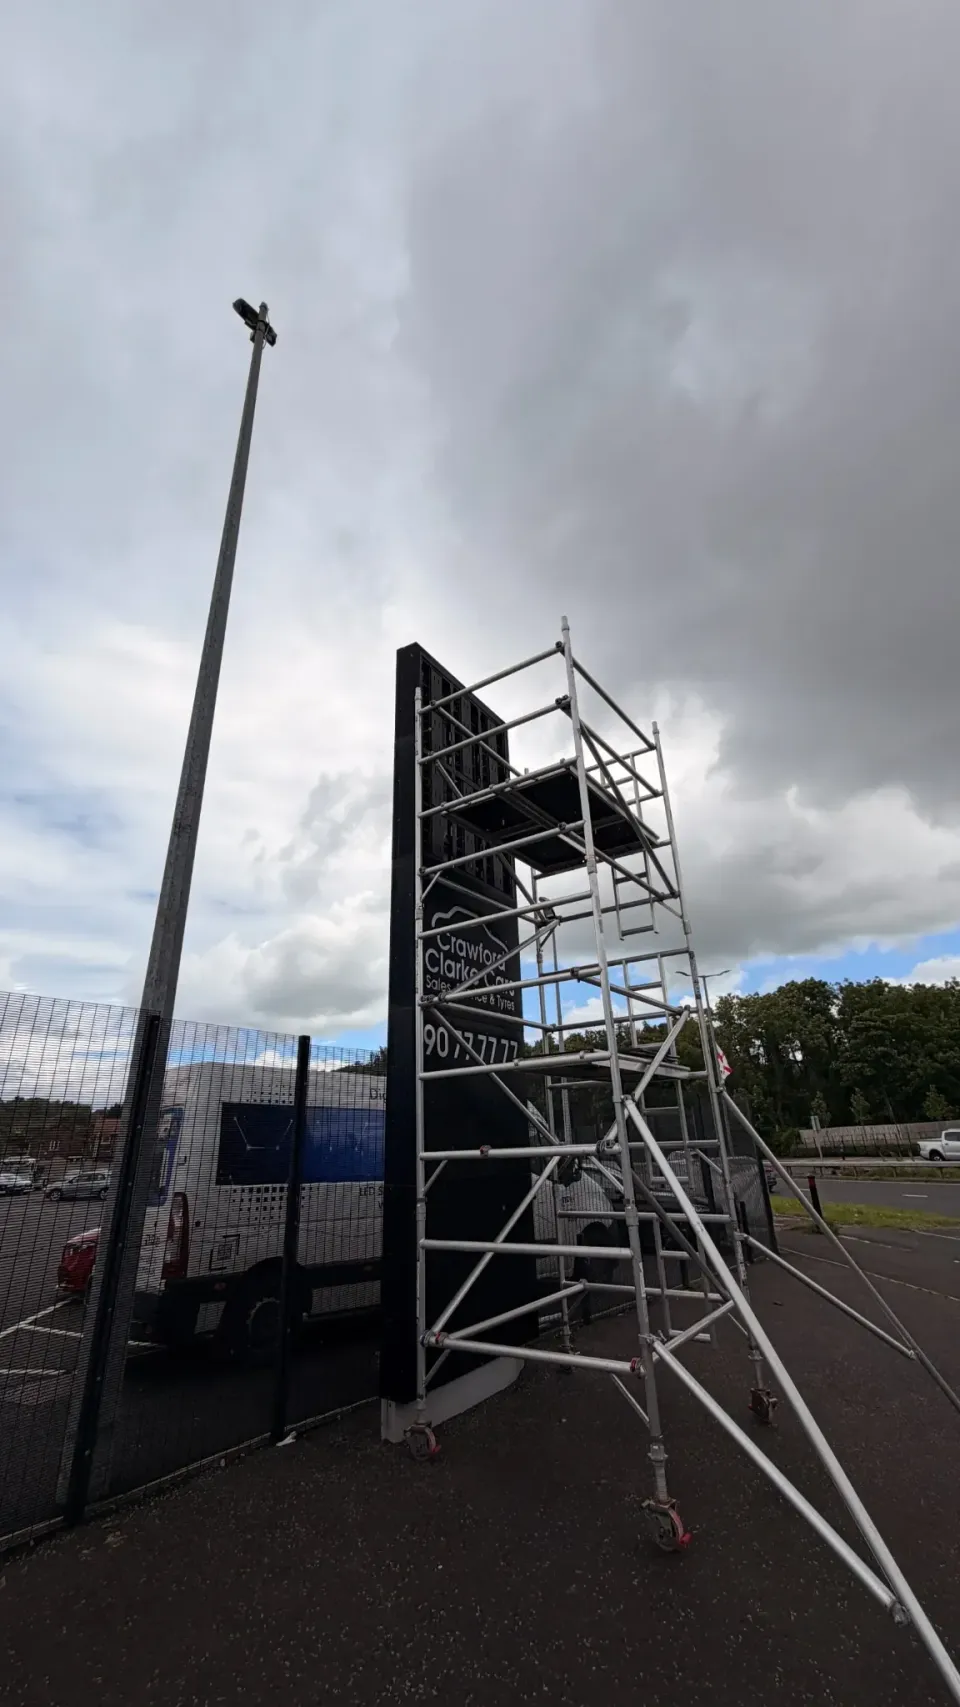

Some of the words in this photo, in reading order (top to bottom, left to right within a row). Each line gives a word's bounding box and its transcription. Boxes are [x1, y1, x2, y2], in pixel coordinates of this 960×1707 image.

[425, 948, 480, 985] Clarke
[437, 933, 506, 971] Crawford
[496, 994, 515, 1011] Tyres
